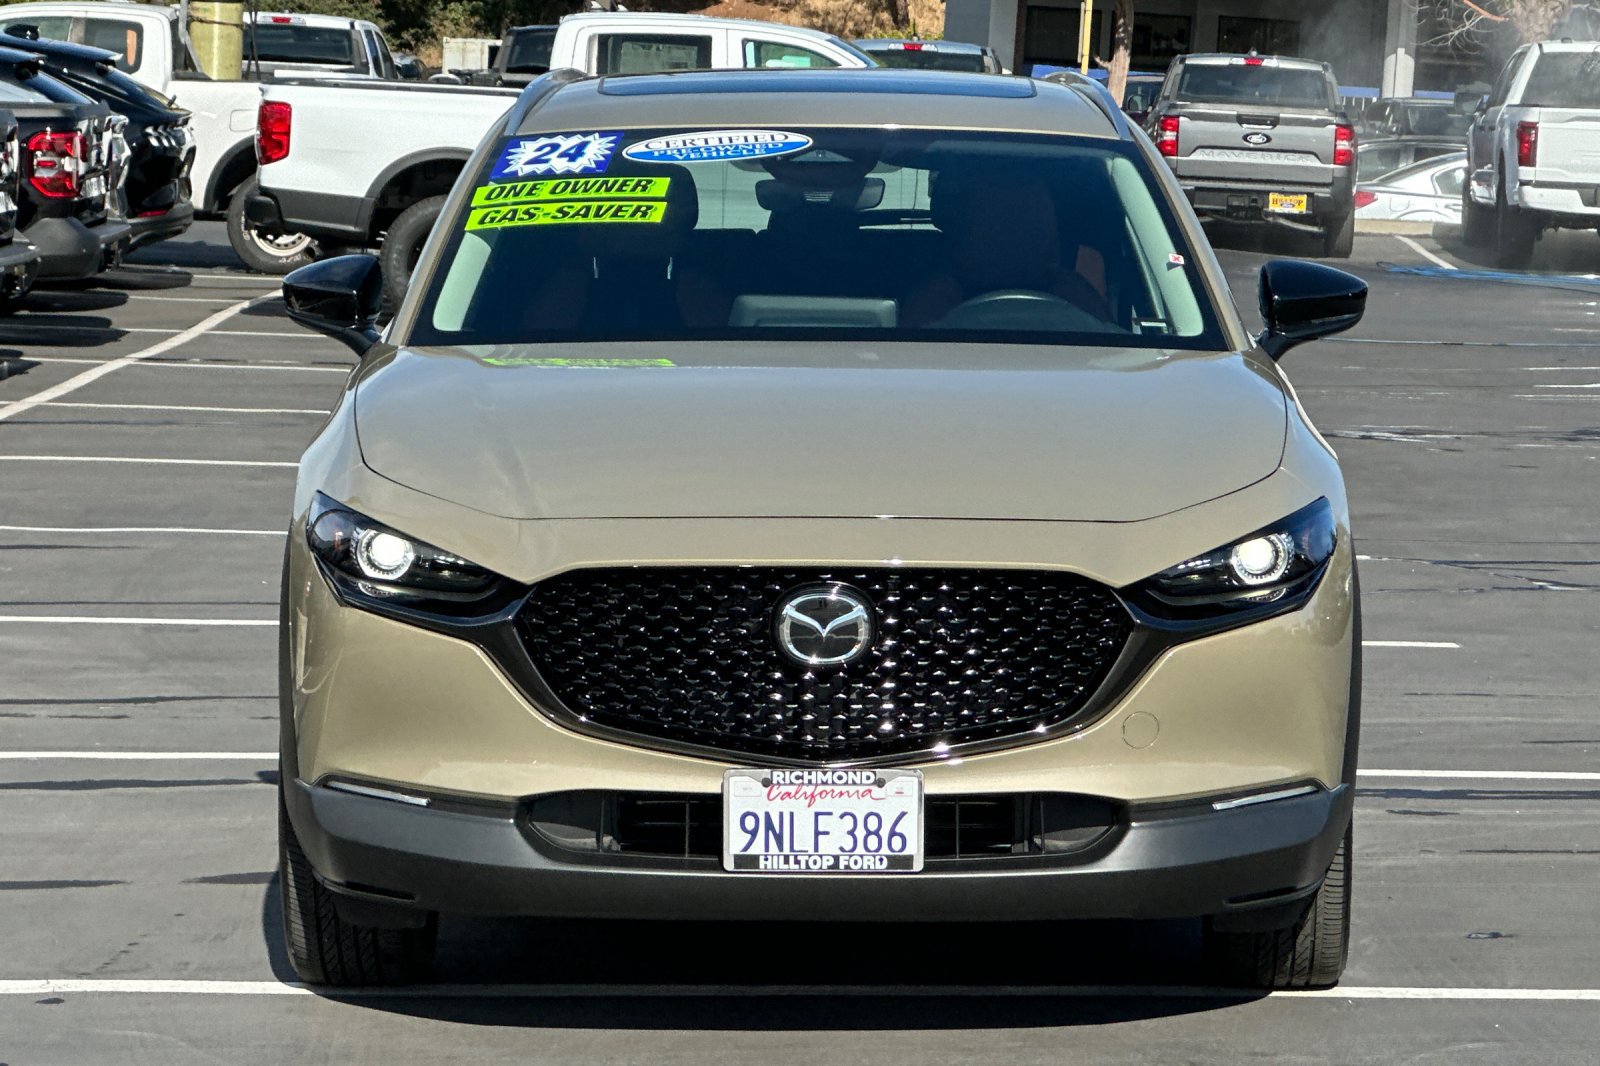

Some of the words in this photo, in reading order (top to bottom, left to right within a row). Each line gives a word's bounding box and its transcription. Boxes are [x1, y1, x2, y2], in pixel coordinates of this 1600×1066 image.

[645, 133, 789, 151] CERTIFIED
[652, 142, 784, 157] PRE-OWNED
[522, 140, 592, 166] 24
[674, 148, 767, 160] VEHICLE
[1199, 149, 1312, 163] MAVERICK
[483, 181, 546, 201] ONE
[549, 178, 656, 195] OWNER
[477, 204, 656, 226] GAS-SAVER
[771, 771, 876, 785] RICHMOND
[766, 783, 886, 808] California
[739, 811, 909, 853] 9NLF386
[759, 855, 835, 870] HILLTOP
[838, 855, 888, 870] FORD
